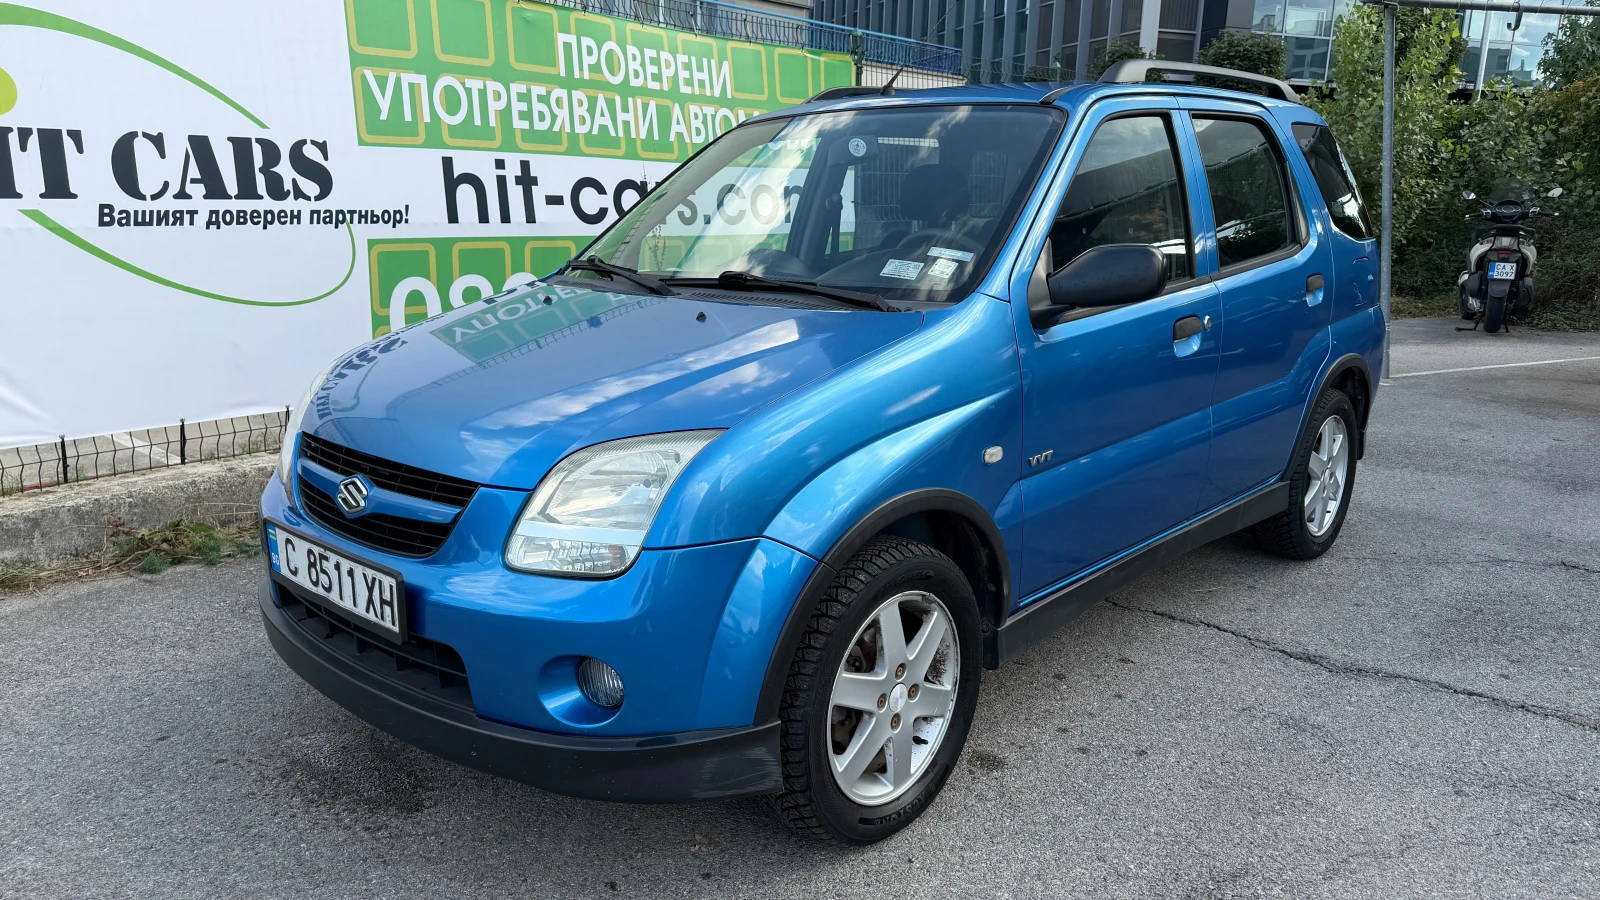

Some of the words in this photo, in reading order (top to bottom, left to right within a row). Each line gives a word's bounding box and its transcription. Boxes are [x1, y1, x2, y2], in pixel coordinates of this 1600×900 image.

[557, 32, 733, 99] ПРОВЕРЕНИ
[363, 69, 659, 141] УПОТРЕБЯВАНИ
[111, 130, 334, 202] CARS
[98, 203, 199, 228] Вашият
[205, 209, 302, 230] доверен
[309, 204, 410, 230] партньор!
[284, 537, 298, 577] C
[306, 548, 358, 609] 8511
[362, 571, 397, 628] XH
